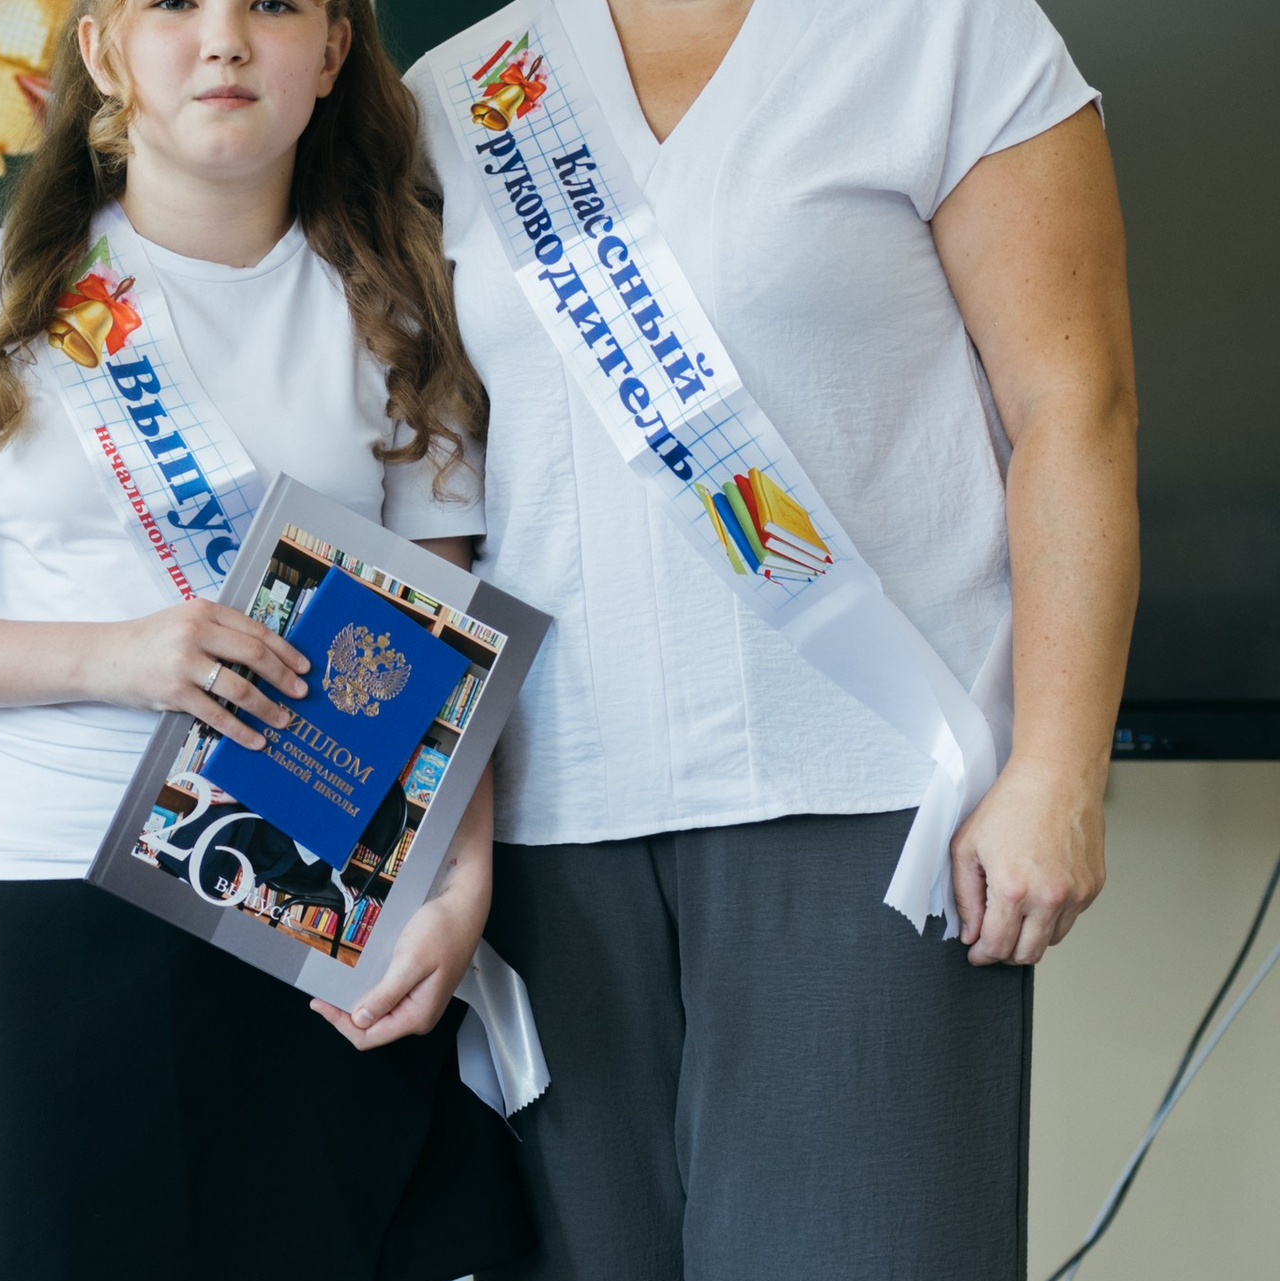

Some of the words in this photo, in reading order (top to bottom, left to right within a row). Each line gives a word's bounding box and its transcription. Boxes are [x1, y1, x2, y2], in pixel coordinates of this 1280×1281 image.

[475, 131, 696, 481] руководитель
[552, 143, 715, 405] Классный
[94, 424, 178, 561] начальной
[166, 563, 198, 601] шк
[105, 354, 241, 584] Выпус
[262, 727, 282, 743] ОБ
[282, 741, 355, 797] ОКОНЧАНИИ
[263, 745, 312, 783] АЛЬНОЙ
[312, 779, 360, 818] ШКОЛЫ
[279, 702, 375, 785] ИПЛОМ
[138, 771, 264, 907] 26
